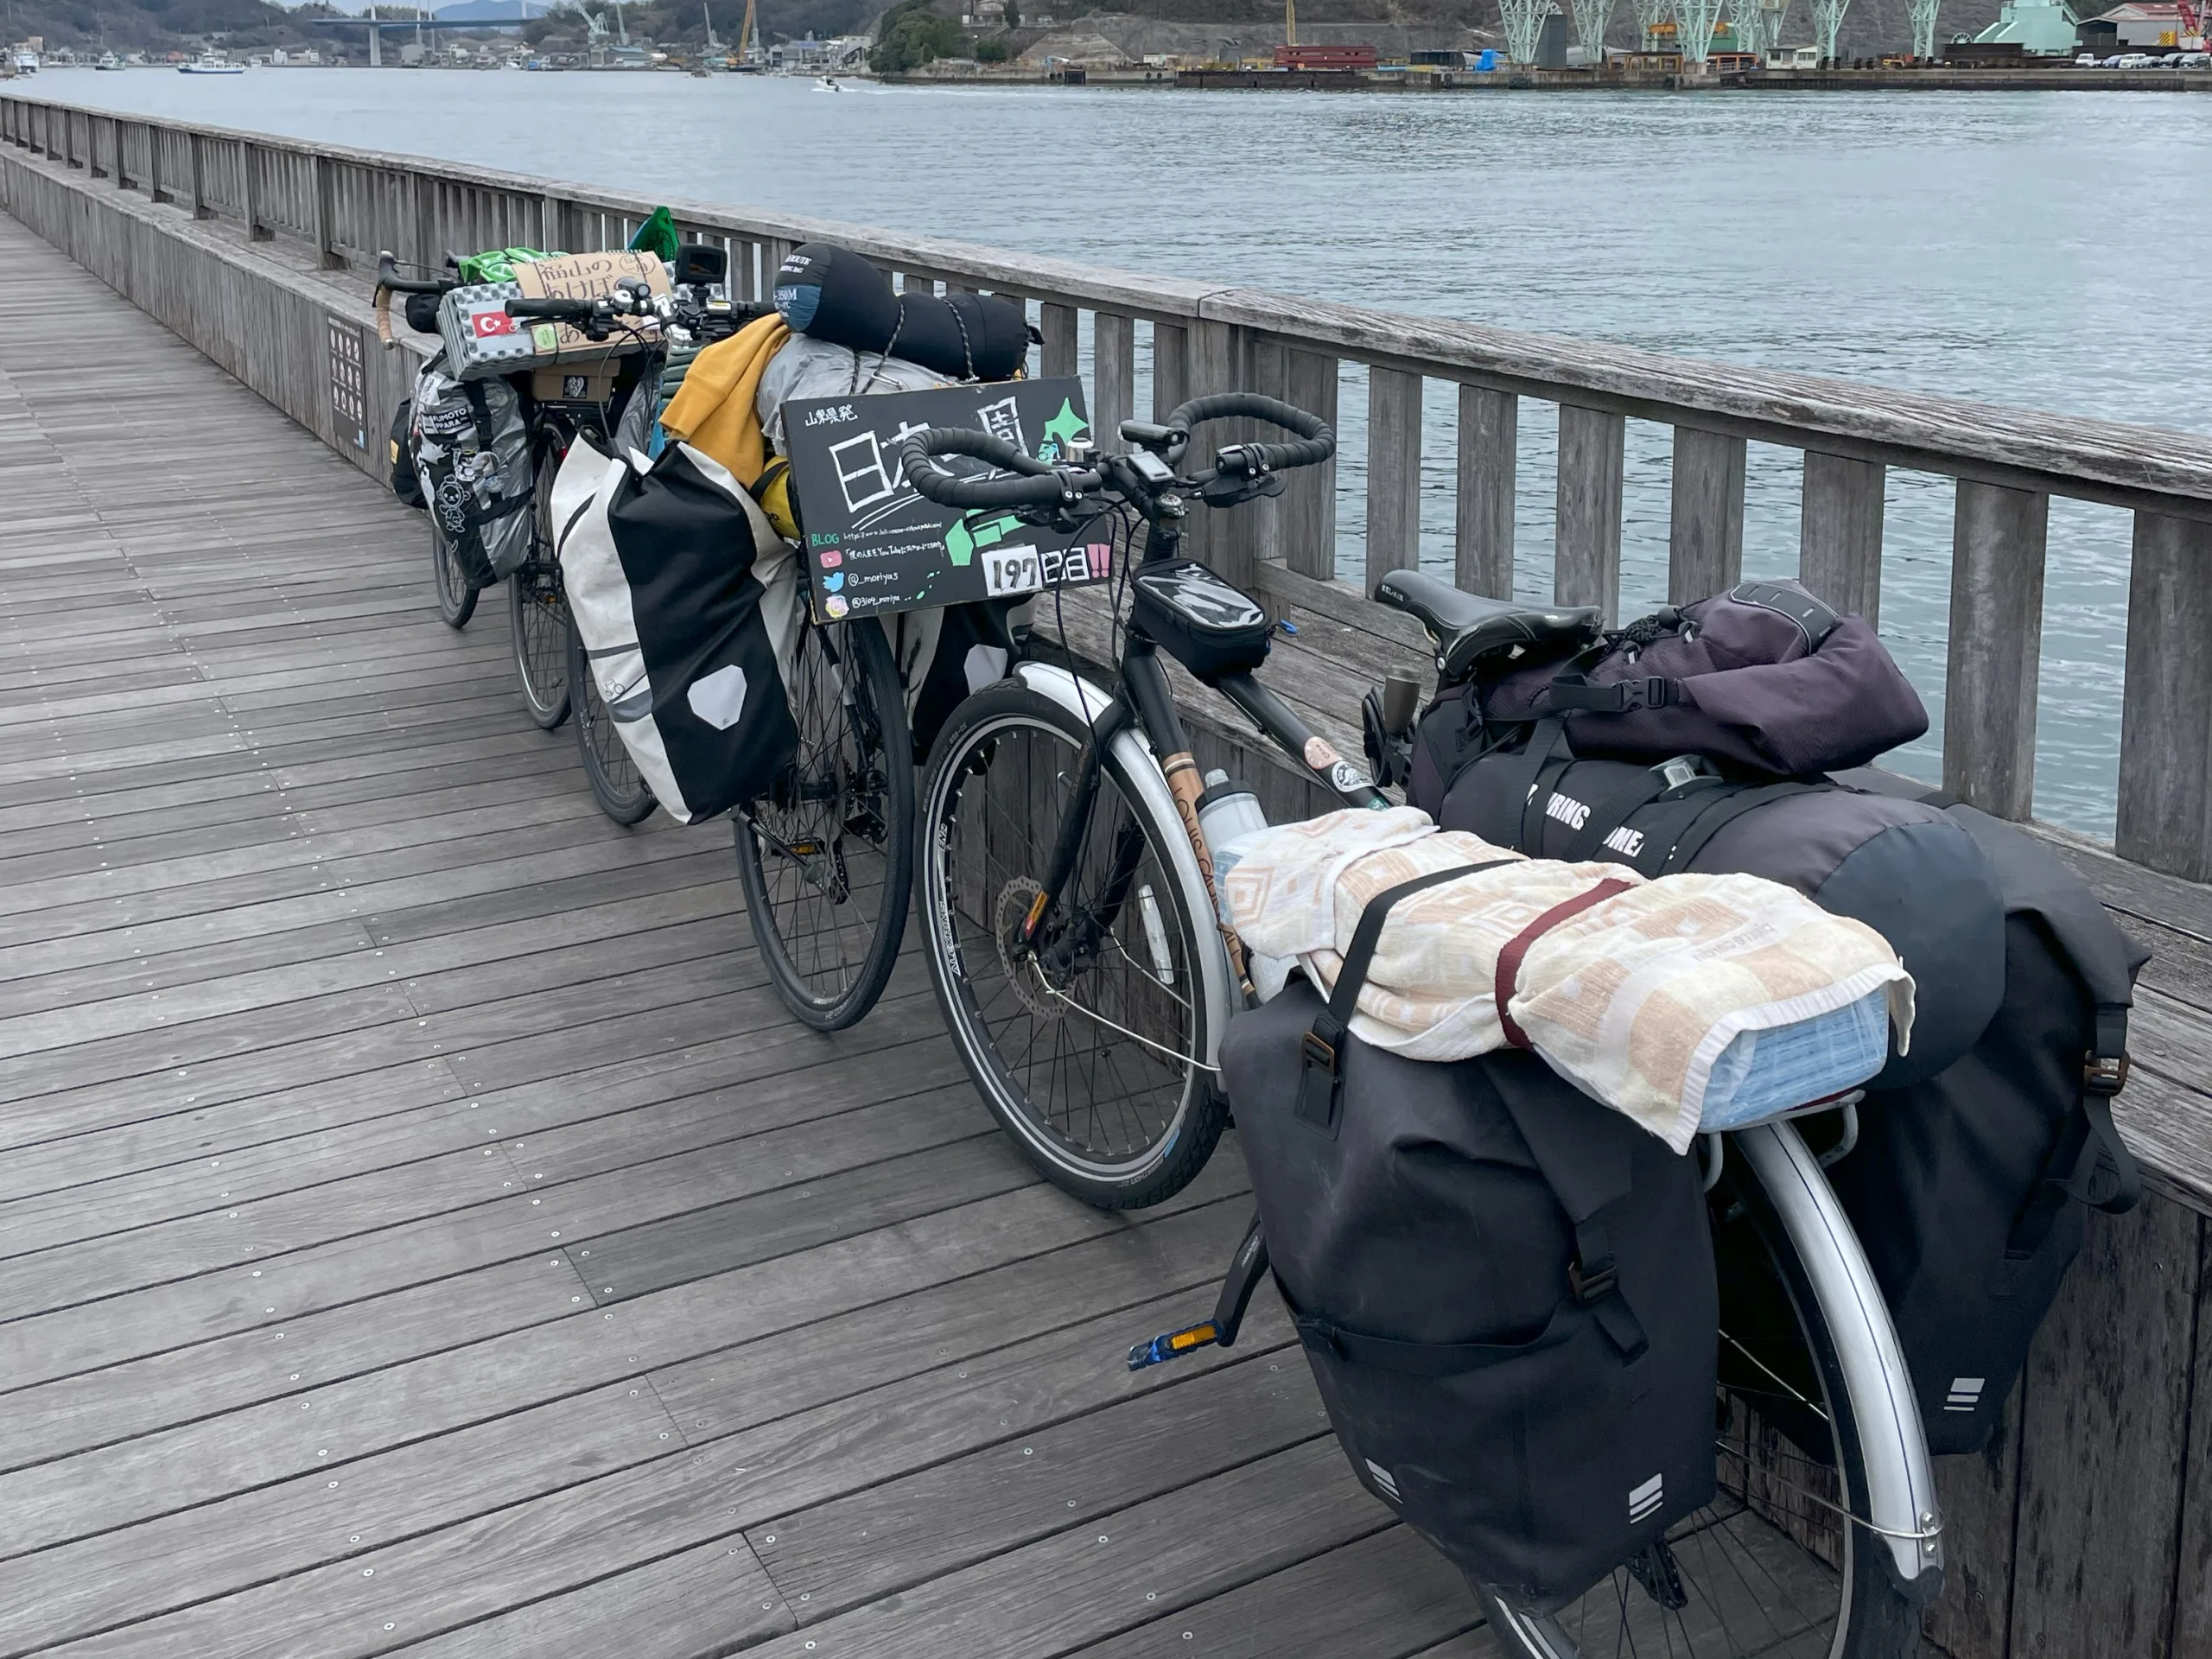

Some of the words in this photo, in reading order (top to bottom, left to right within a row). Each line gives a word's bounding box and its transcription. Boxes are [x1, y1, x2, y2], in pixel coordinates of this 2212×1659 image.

[539, 259, 612, 281] 福山の
[804, 404, 858, 426] 山梨県発
[811, 533, 839, 546] BLOG
